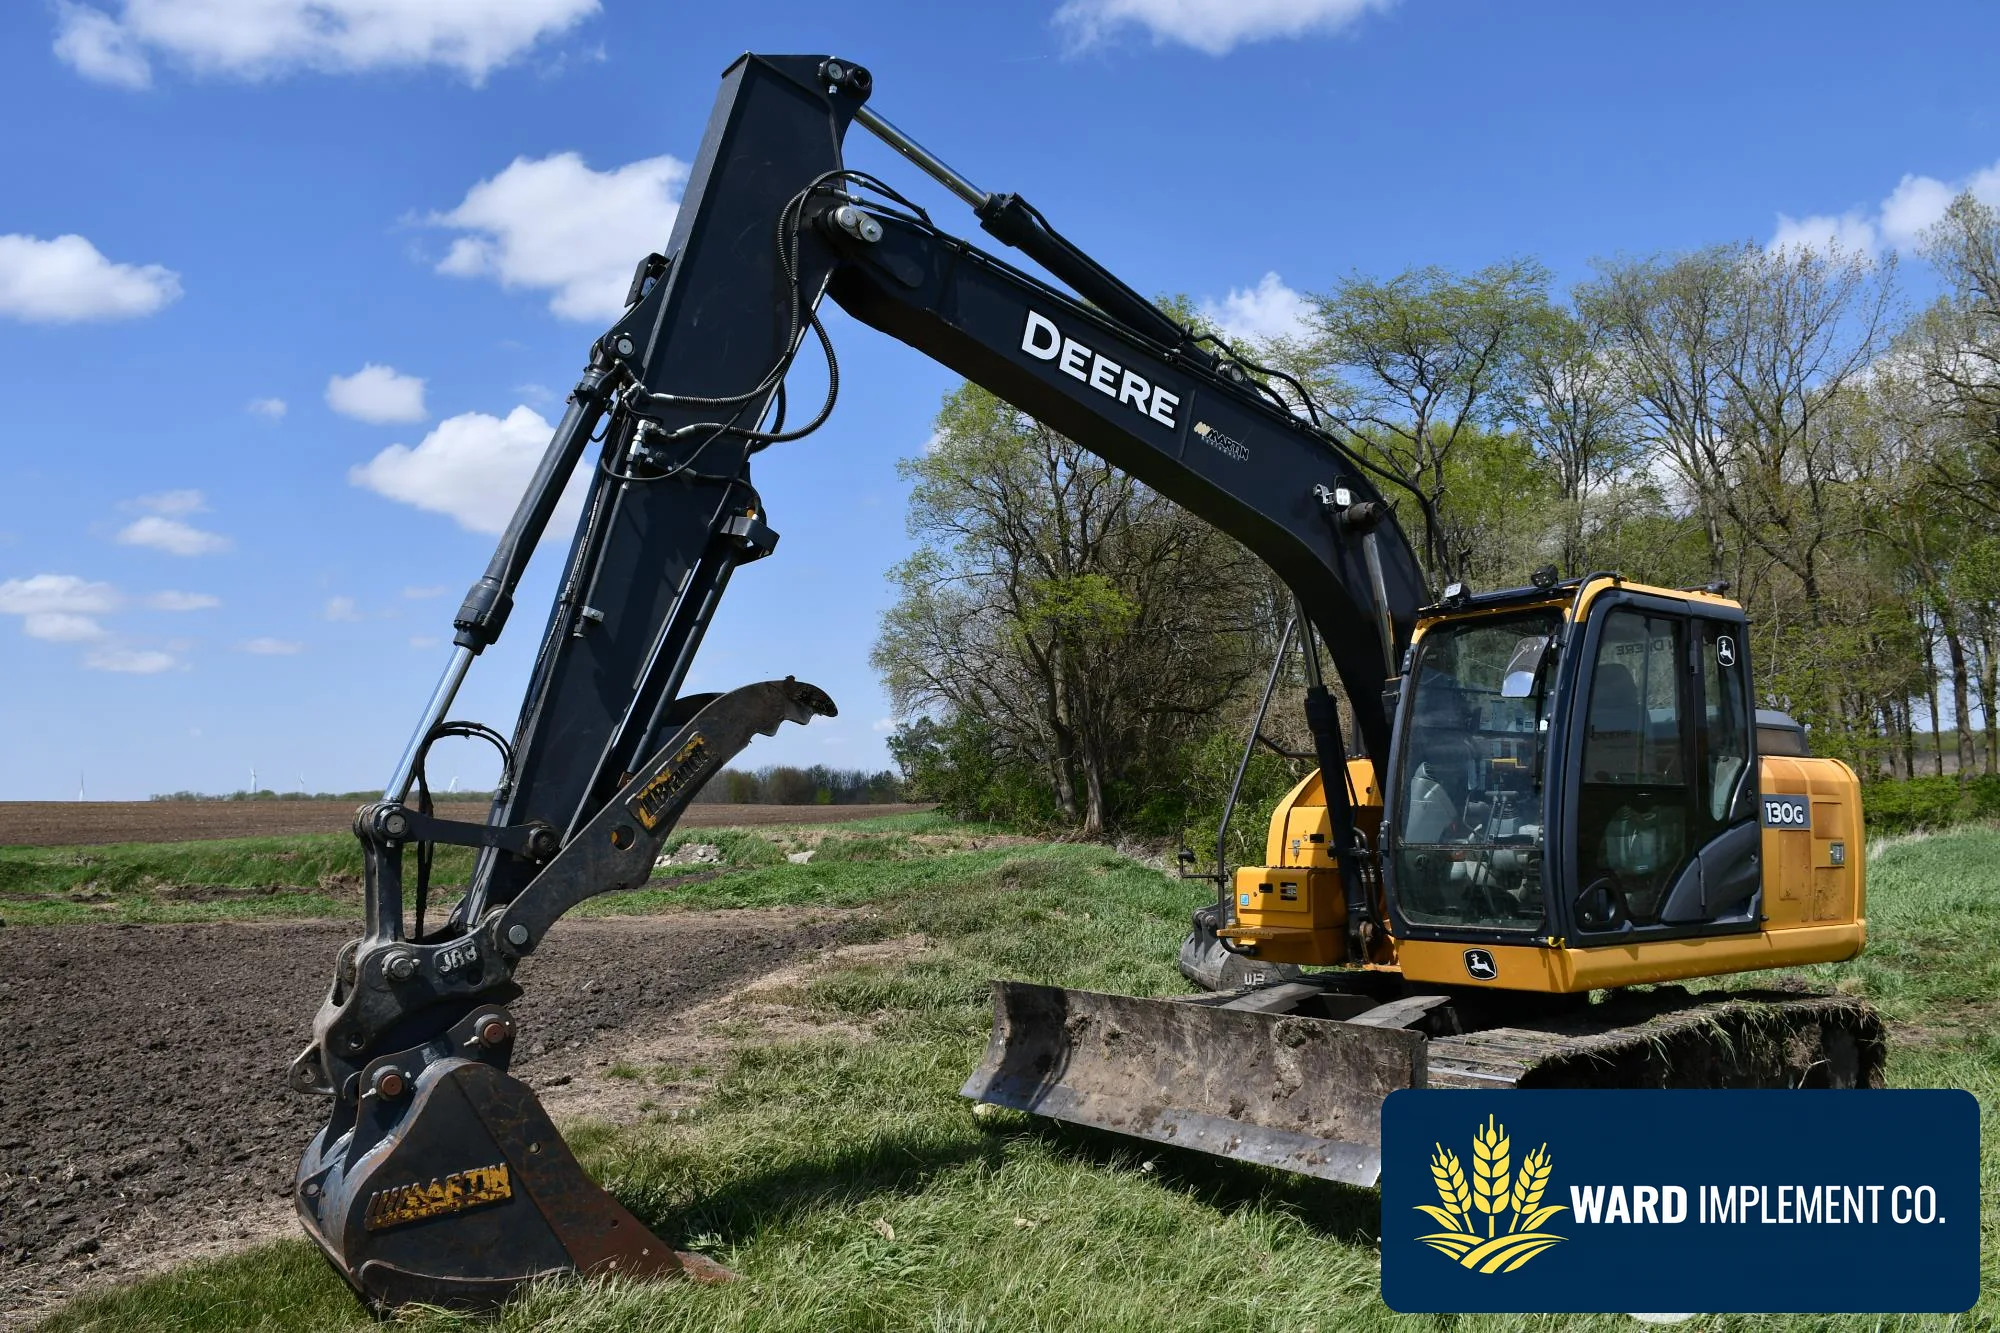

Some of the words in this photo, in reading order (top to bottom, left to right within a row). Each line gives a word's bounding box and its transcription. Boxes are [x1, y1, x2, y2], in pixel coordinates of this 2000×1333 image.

[1021, 309, 1180, 429] DEERE
[1204, 426, 1249, 462] MARTIN
[1764, 801, 1805, 825] 130G
[396, 1162, 512, 1212] MARTIN
